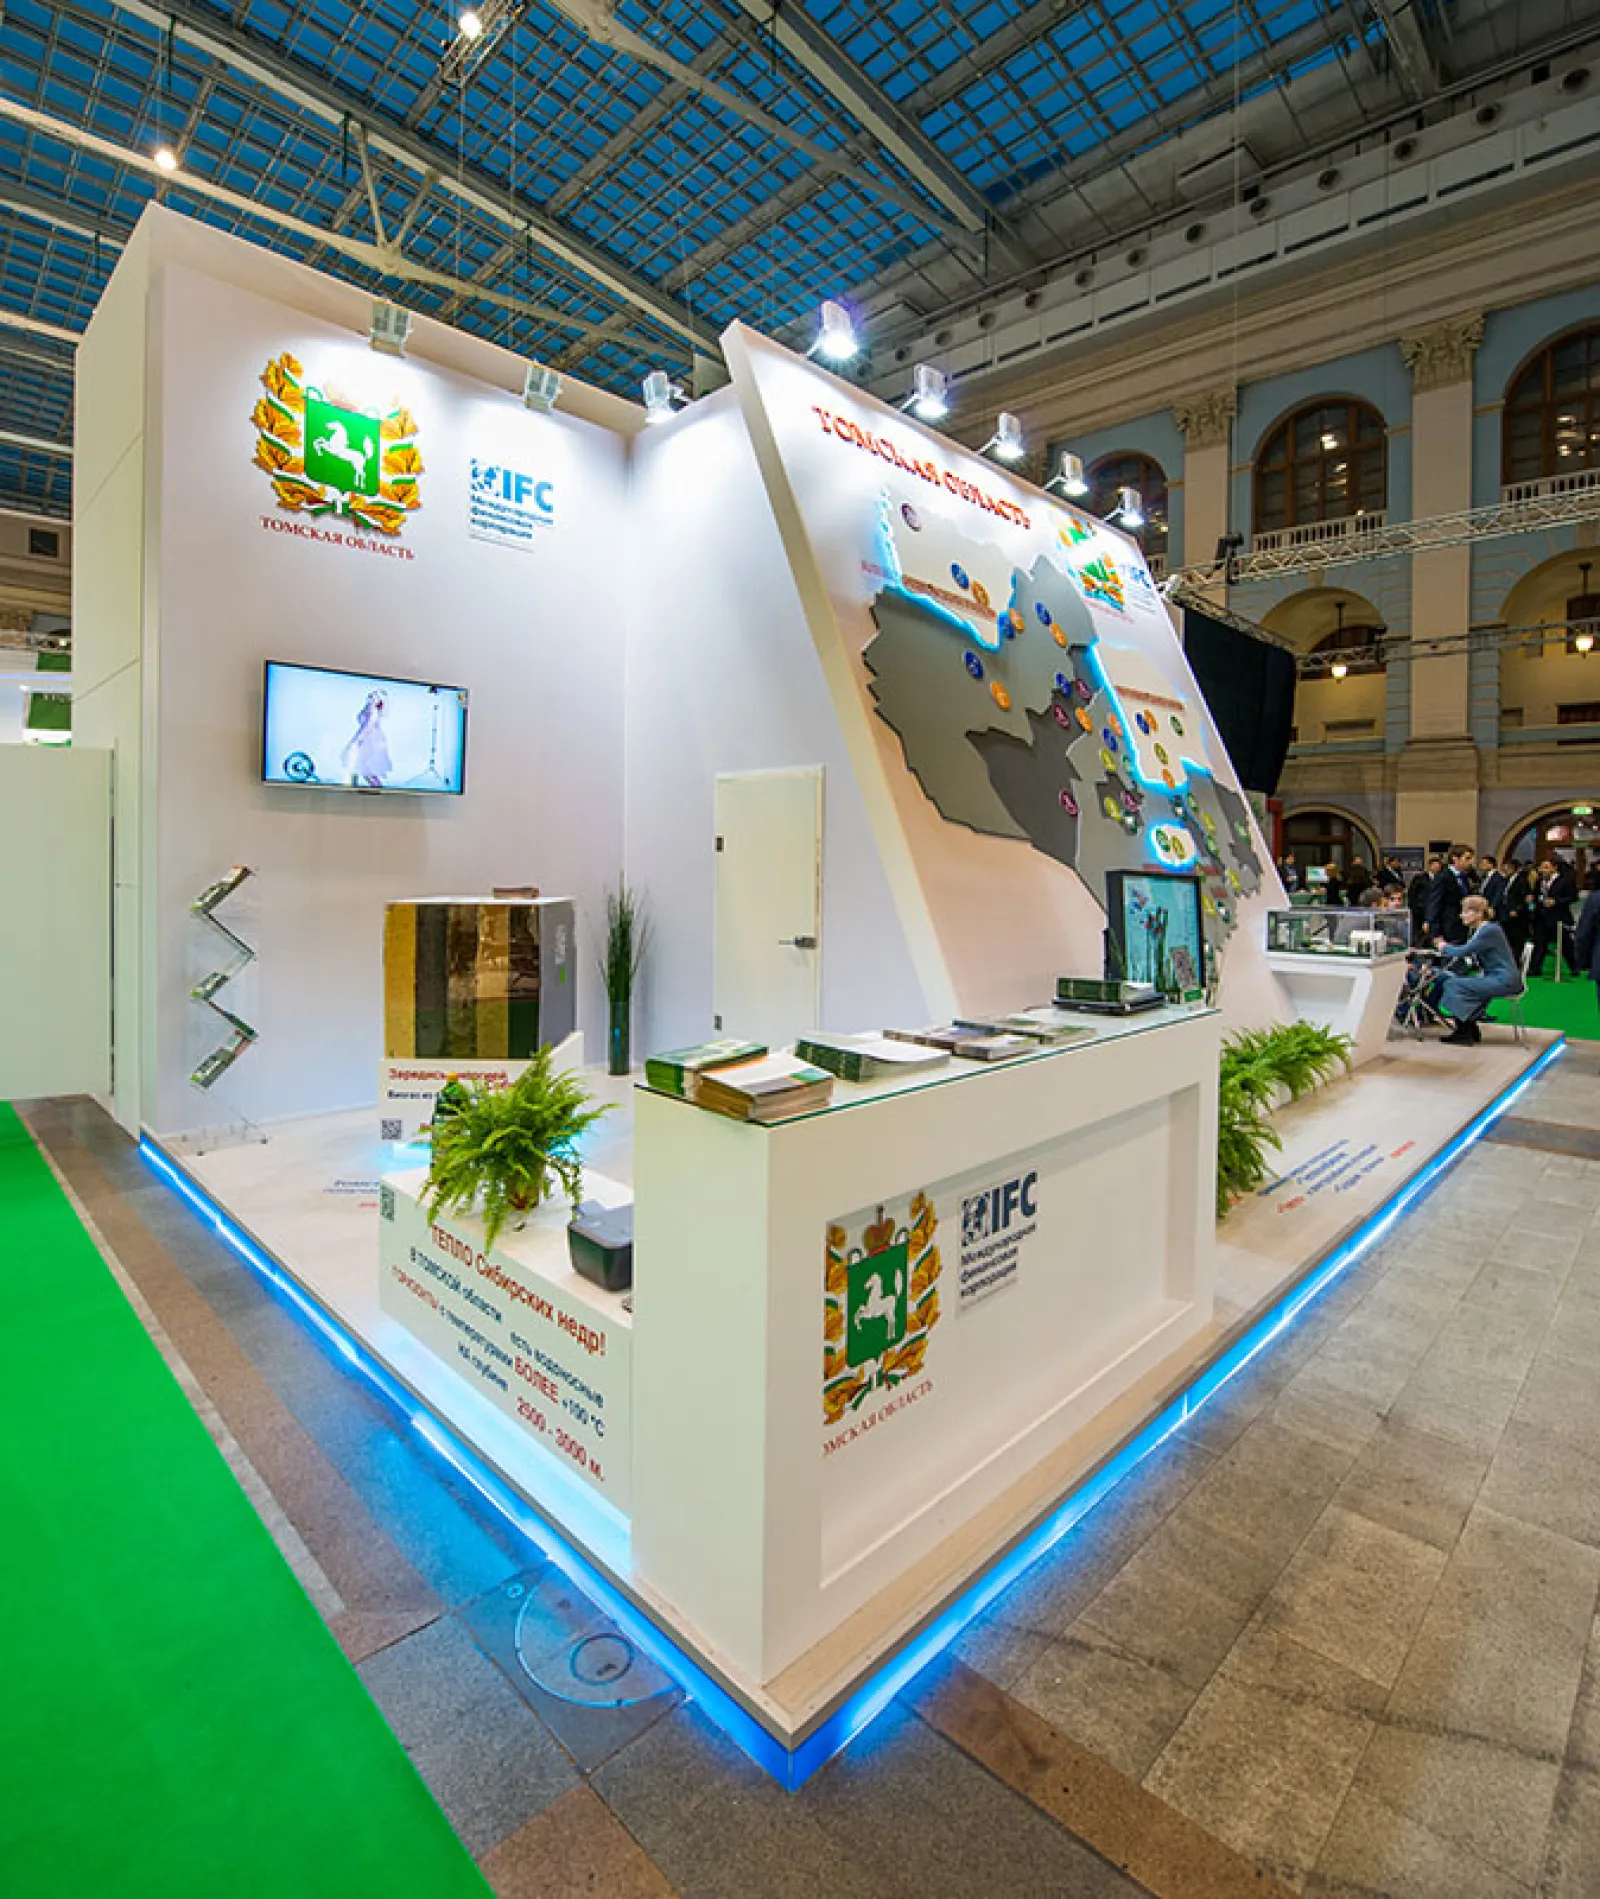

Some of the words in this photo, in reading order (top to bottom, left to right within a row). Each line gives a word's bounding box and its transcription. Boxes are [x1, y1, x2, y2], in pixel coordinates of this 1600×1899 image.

[812, 405, 941, 487] ТОМСКАЯ
[503, 469, 553, 513] IFC
[260, 516, 343, 545] ТОМСКАЯ
[345, 535, 415, 560] ОБЛАСТЬ
[991, 1171, 1037, 1234] IFC
[474, 1252, 554, 1323] Сибирских
[514, 1355, 560, 1405] БОЛЕЕ
